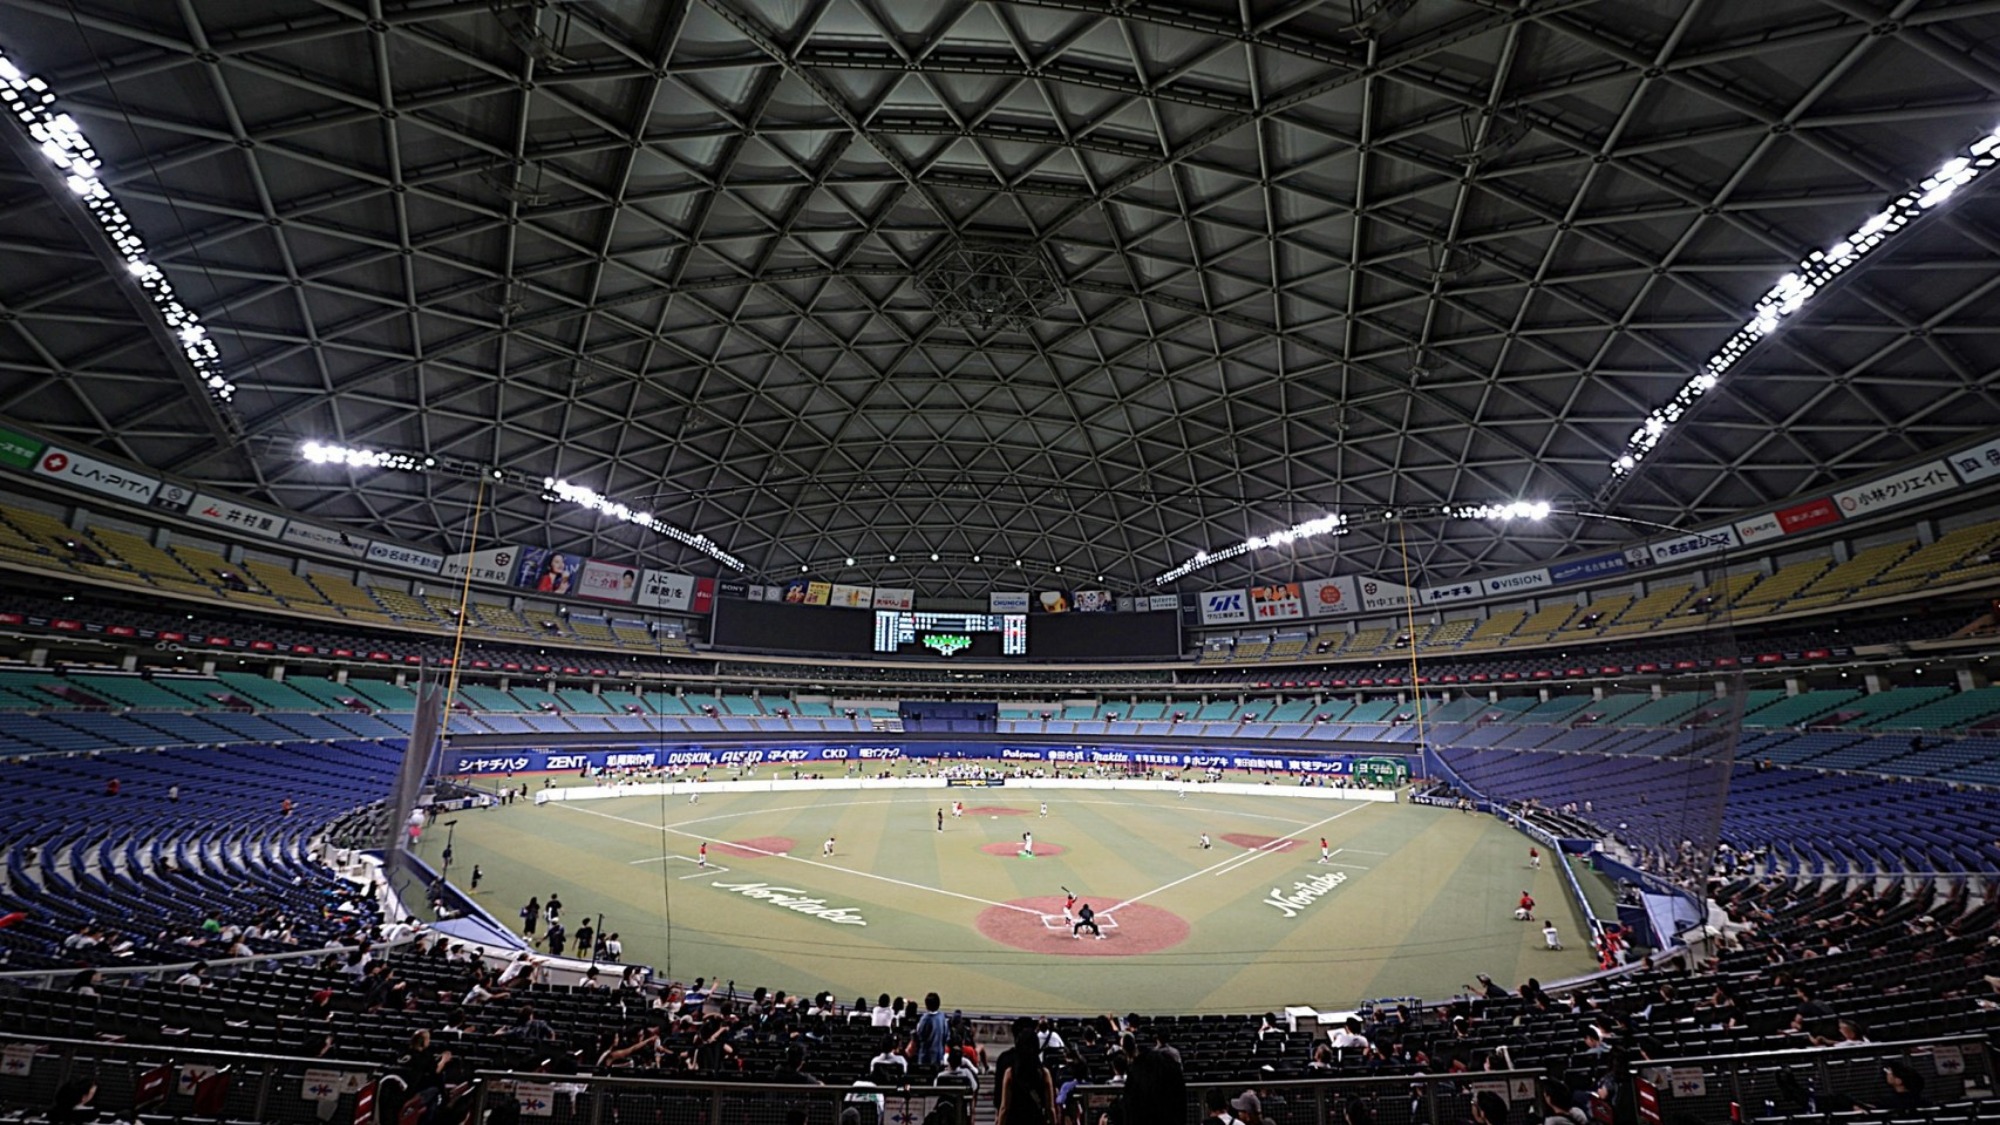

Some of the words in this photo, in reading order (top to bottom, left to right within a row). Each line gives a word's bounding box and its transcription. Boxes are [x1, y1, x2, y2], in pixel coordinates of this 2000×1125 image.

[1858, 468, 1949, 506] 小林クリエイト
[225, 508, 274, 531] 井村屋
[448, 563, 507, 582] 竹中工務店
[720, 583, 745, 592] SONY
[1500, 573, 1543, 589] VISION
[1430, 586, 1473, 600] ホーチキ
[1258, 602, 1299, 617] KEIZ
[668, 752, 712, 764] DUSKIN
[821, 748, 848, 759] CKD
[1002, 748, 1041, 760] Paloma
[458, 757, 529, 772] シヤチハタ
[546, 755, 587, 769] ZENT
[1288, 759, 1343, 773] 東芝テック
[1262, 870, 1348, 918] Noritake
[711, 881, 867, 927] Noritake
